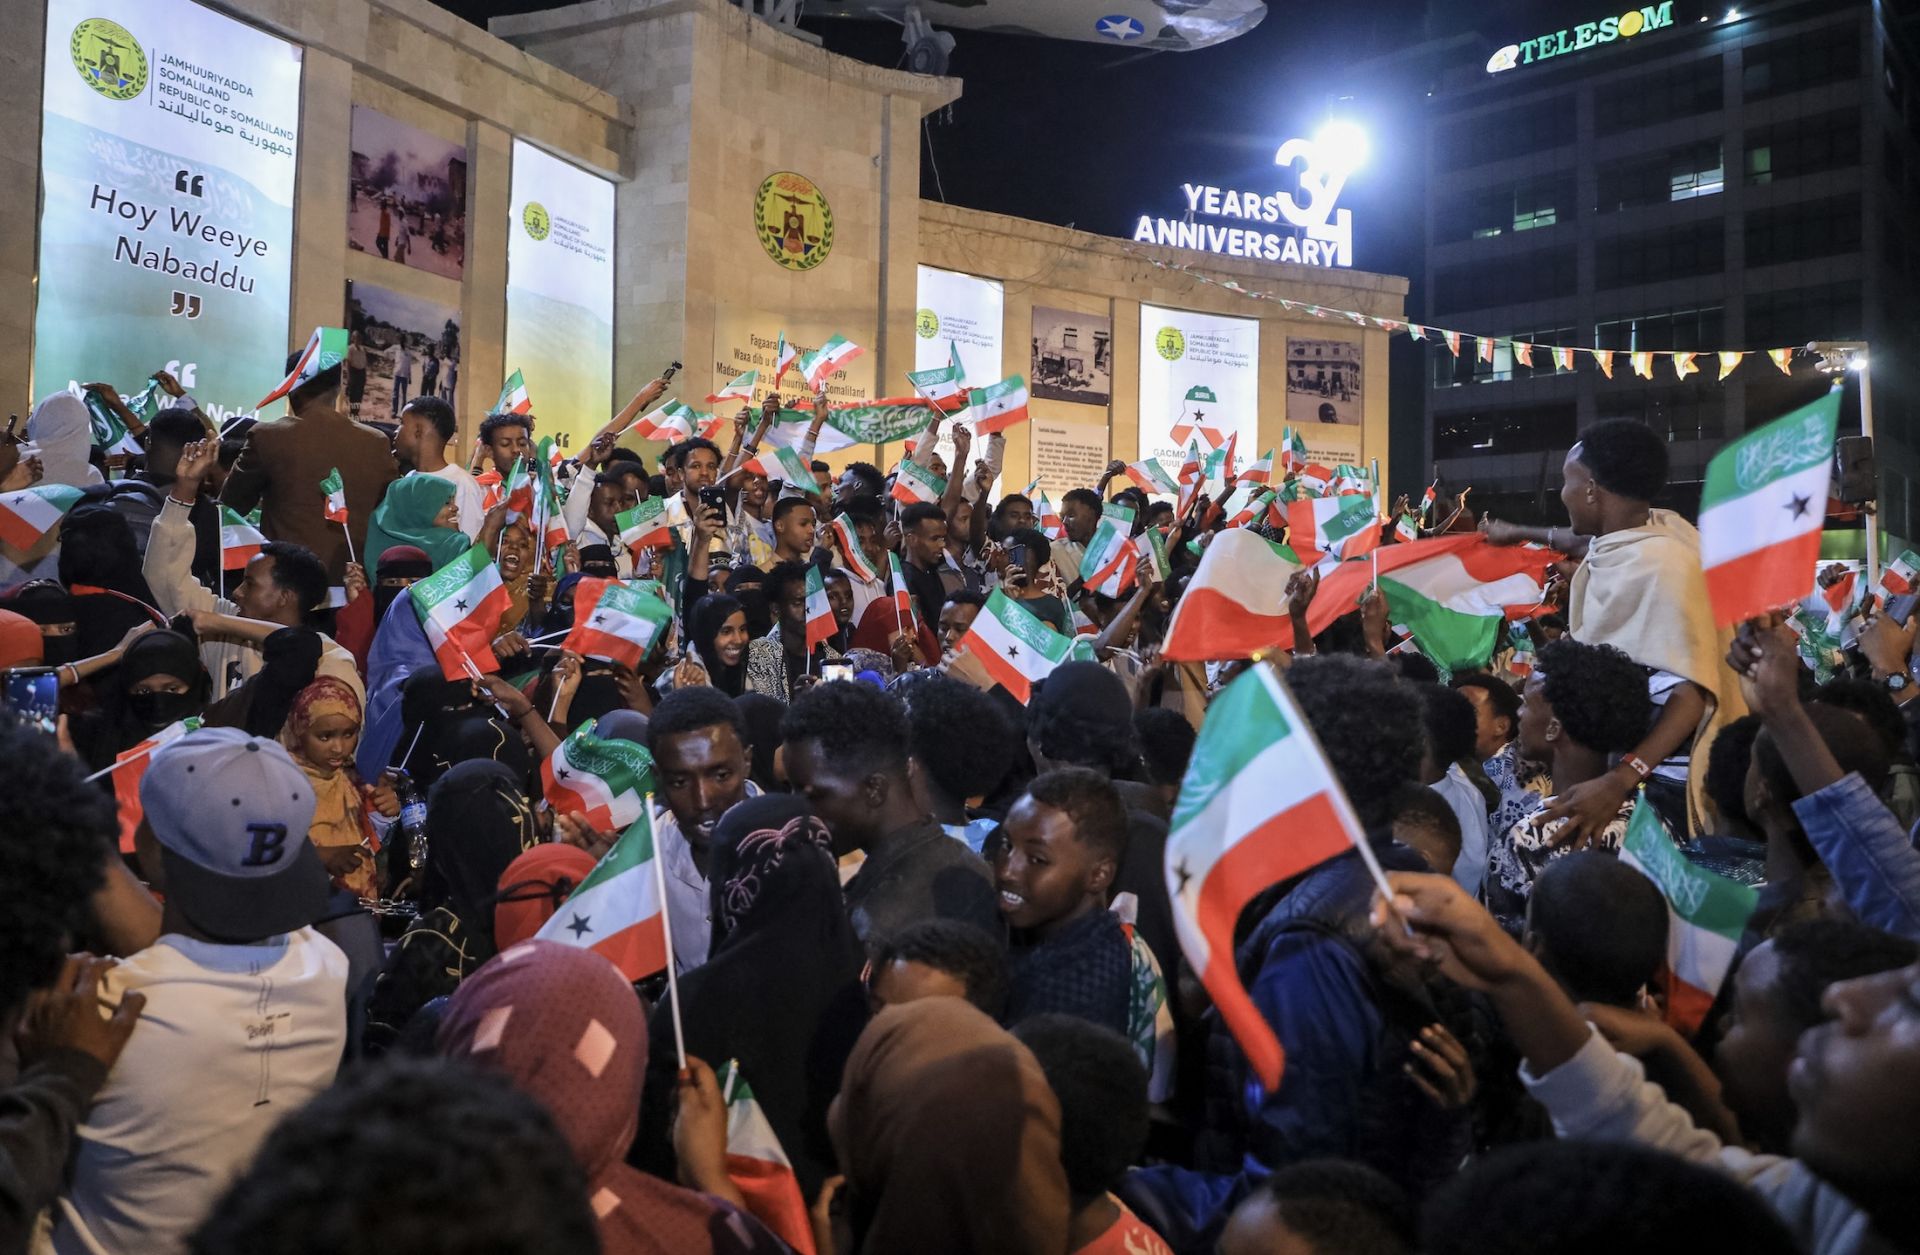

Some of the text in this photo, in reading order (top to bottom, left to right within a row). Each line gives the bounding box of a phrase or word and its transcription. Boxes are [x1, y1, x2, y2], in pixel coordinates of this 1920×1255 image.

[1519, 0, 1673, 65] TELESOM
[159, 67, 231, 102] SOMALILAND
[160, 53, 254, 98] JAMHUURIYADDA
[159, 82, 294, 142] REPUBLIC OF SOMALILAND
[90, 184, 268, 258] Hoy Weeye
[1184, 183, 1280, 223] YEARS
[1134, 215, 1338, 268] ANNIVERSARY
[114, 235, 255, 294] Nabaddu
[734, 347, 751, 362] Waxa
[752, 353, 764, 365] dib
[825, 382, 866, 398] Somaliland
[241, 822, 289, 867] B
